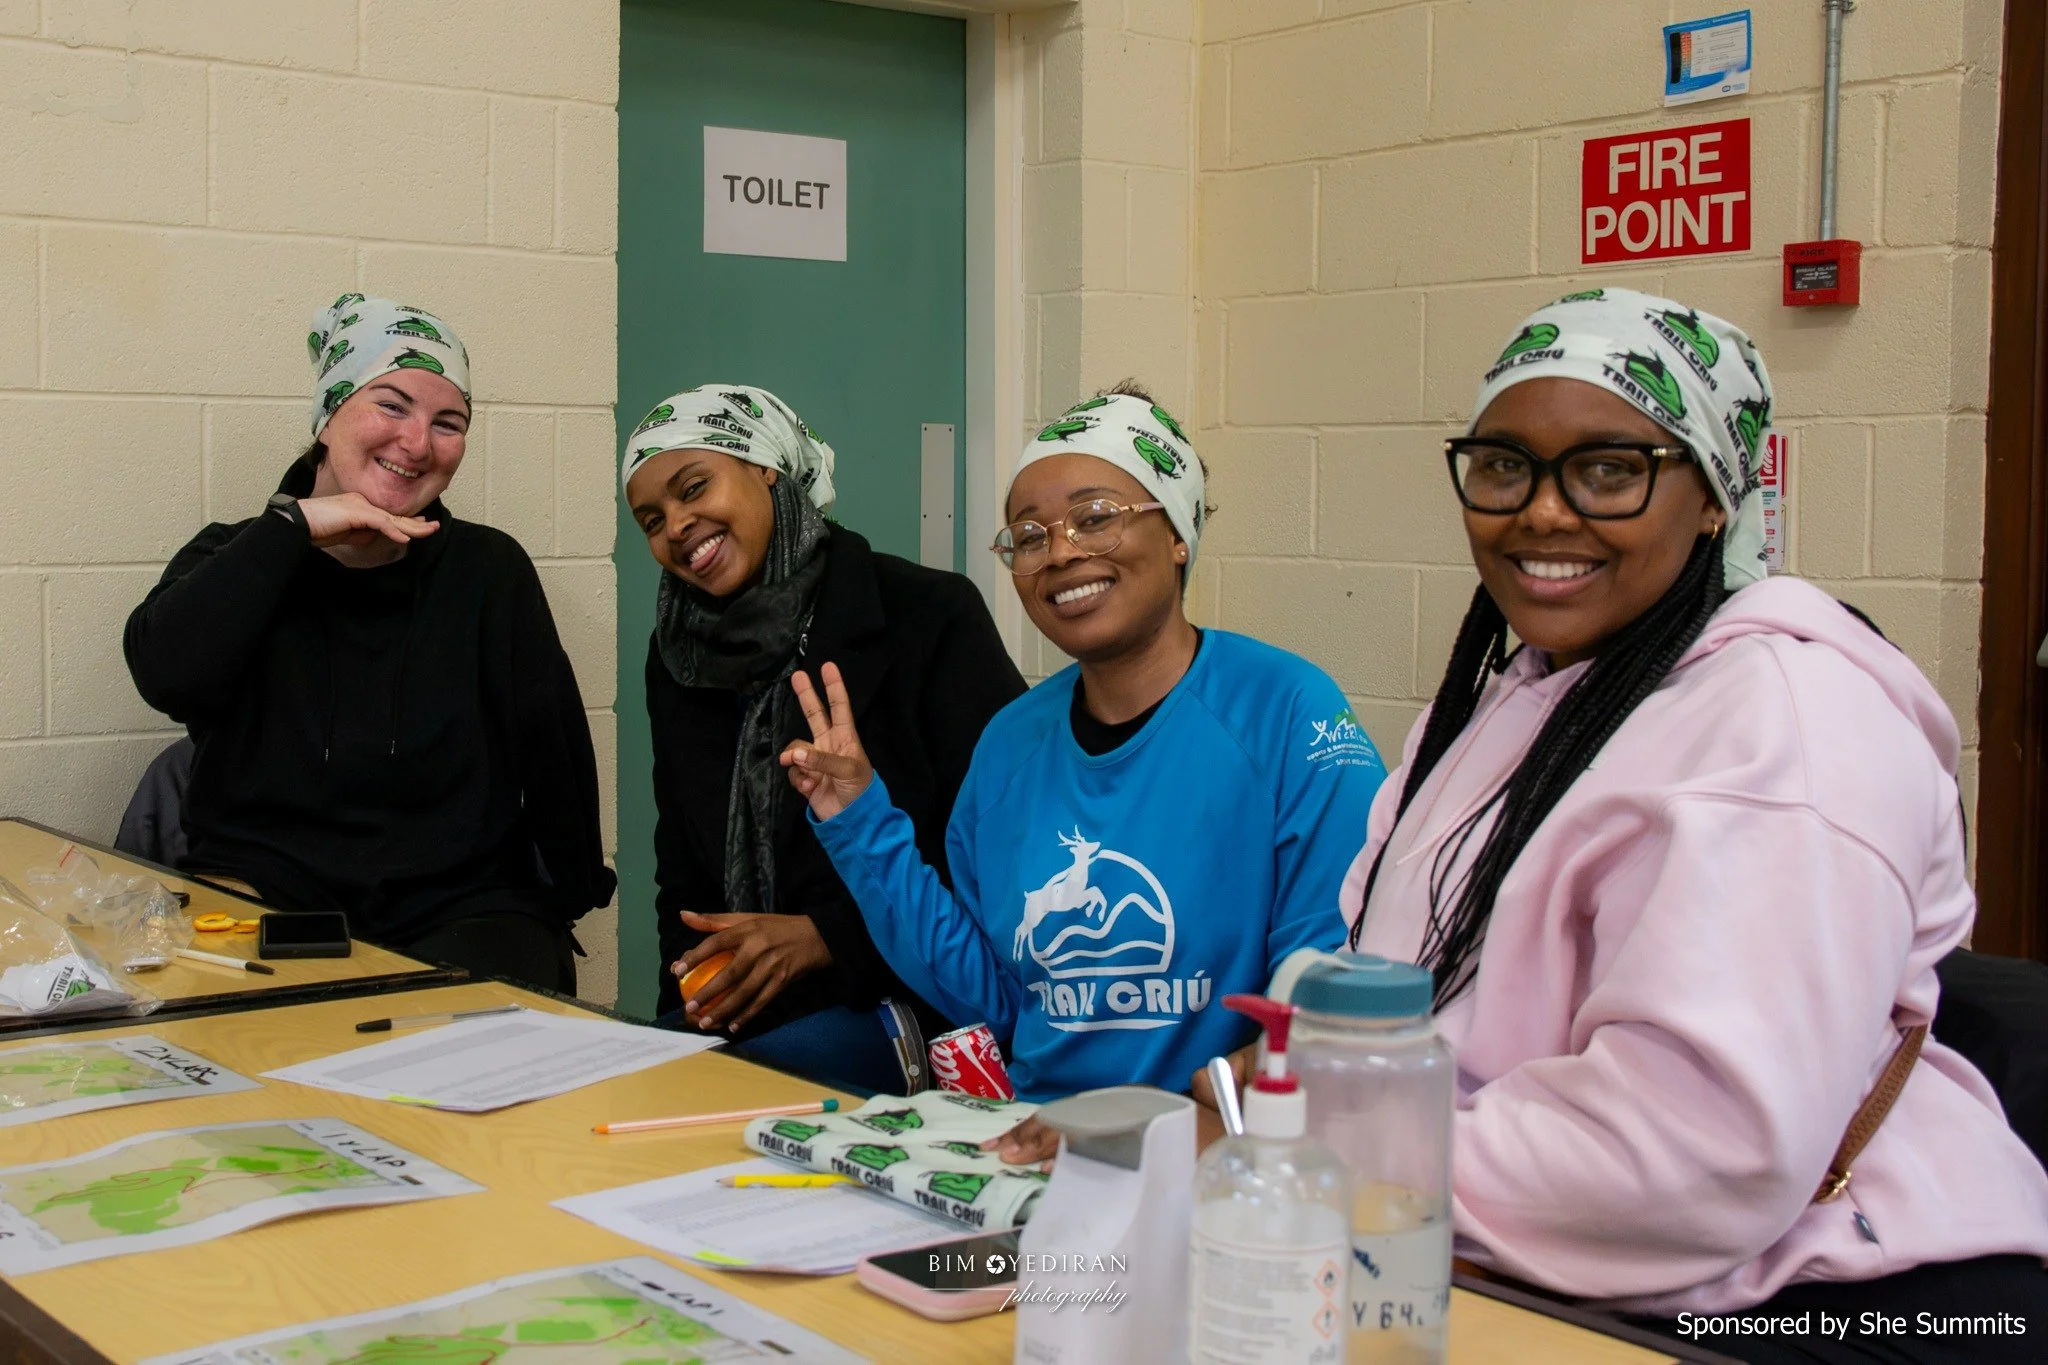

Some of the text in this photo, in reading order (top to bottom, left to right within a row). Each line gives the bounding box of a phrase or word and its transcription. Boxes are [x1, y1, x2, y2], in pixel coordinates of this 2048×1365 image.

[1608, 131, 1723, 194] FIRE
[722, 174, 831, 210] TOILET
[1585, 191, 1746, 256] POINT
[1643, 311, 1685, 350] TRAIL
[1484, 356, 1515, 385] TRAIL
[1602, 363, 1649, 407] TRAIL
[697, 414, 726, 428] TRAIL
[758, 1131, 785, 1154] TRAIL
[831, 1157, 861, 1184] TRAIL
[914, 1188, 950, 1214] TRAIL
